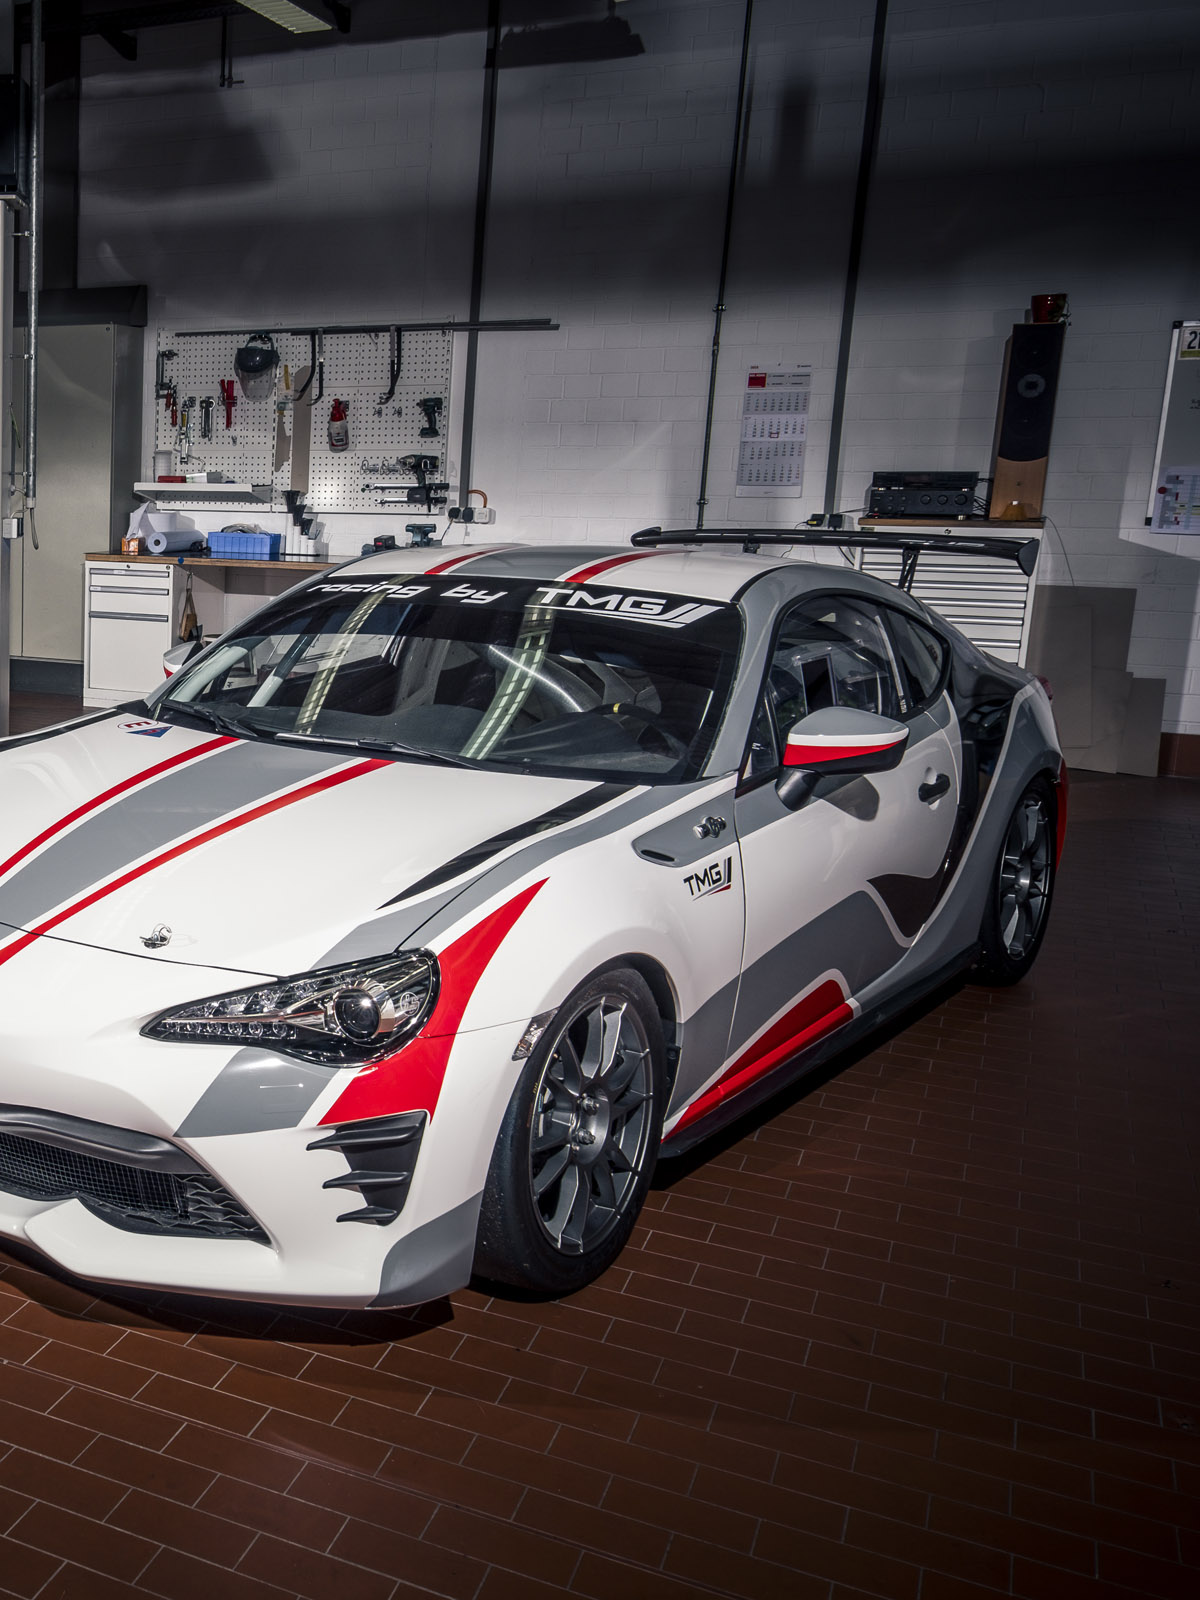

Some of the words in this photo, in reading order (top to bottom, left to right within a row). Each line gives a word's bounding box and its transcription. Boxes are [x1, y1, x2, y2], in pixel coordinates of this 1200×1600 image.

[1187, 331, 1200, 350] 2
[306, 581, 431, 599] racing
[440, 582, 508, 604] by
[535, 587, 668, 615] TMG
[683, 862, 722, 897] TMG
